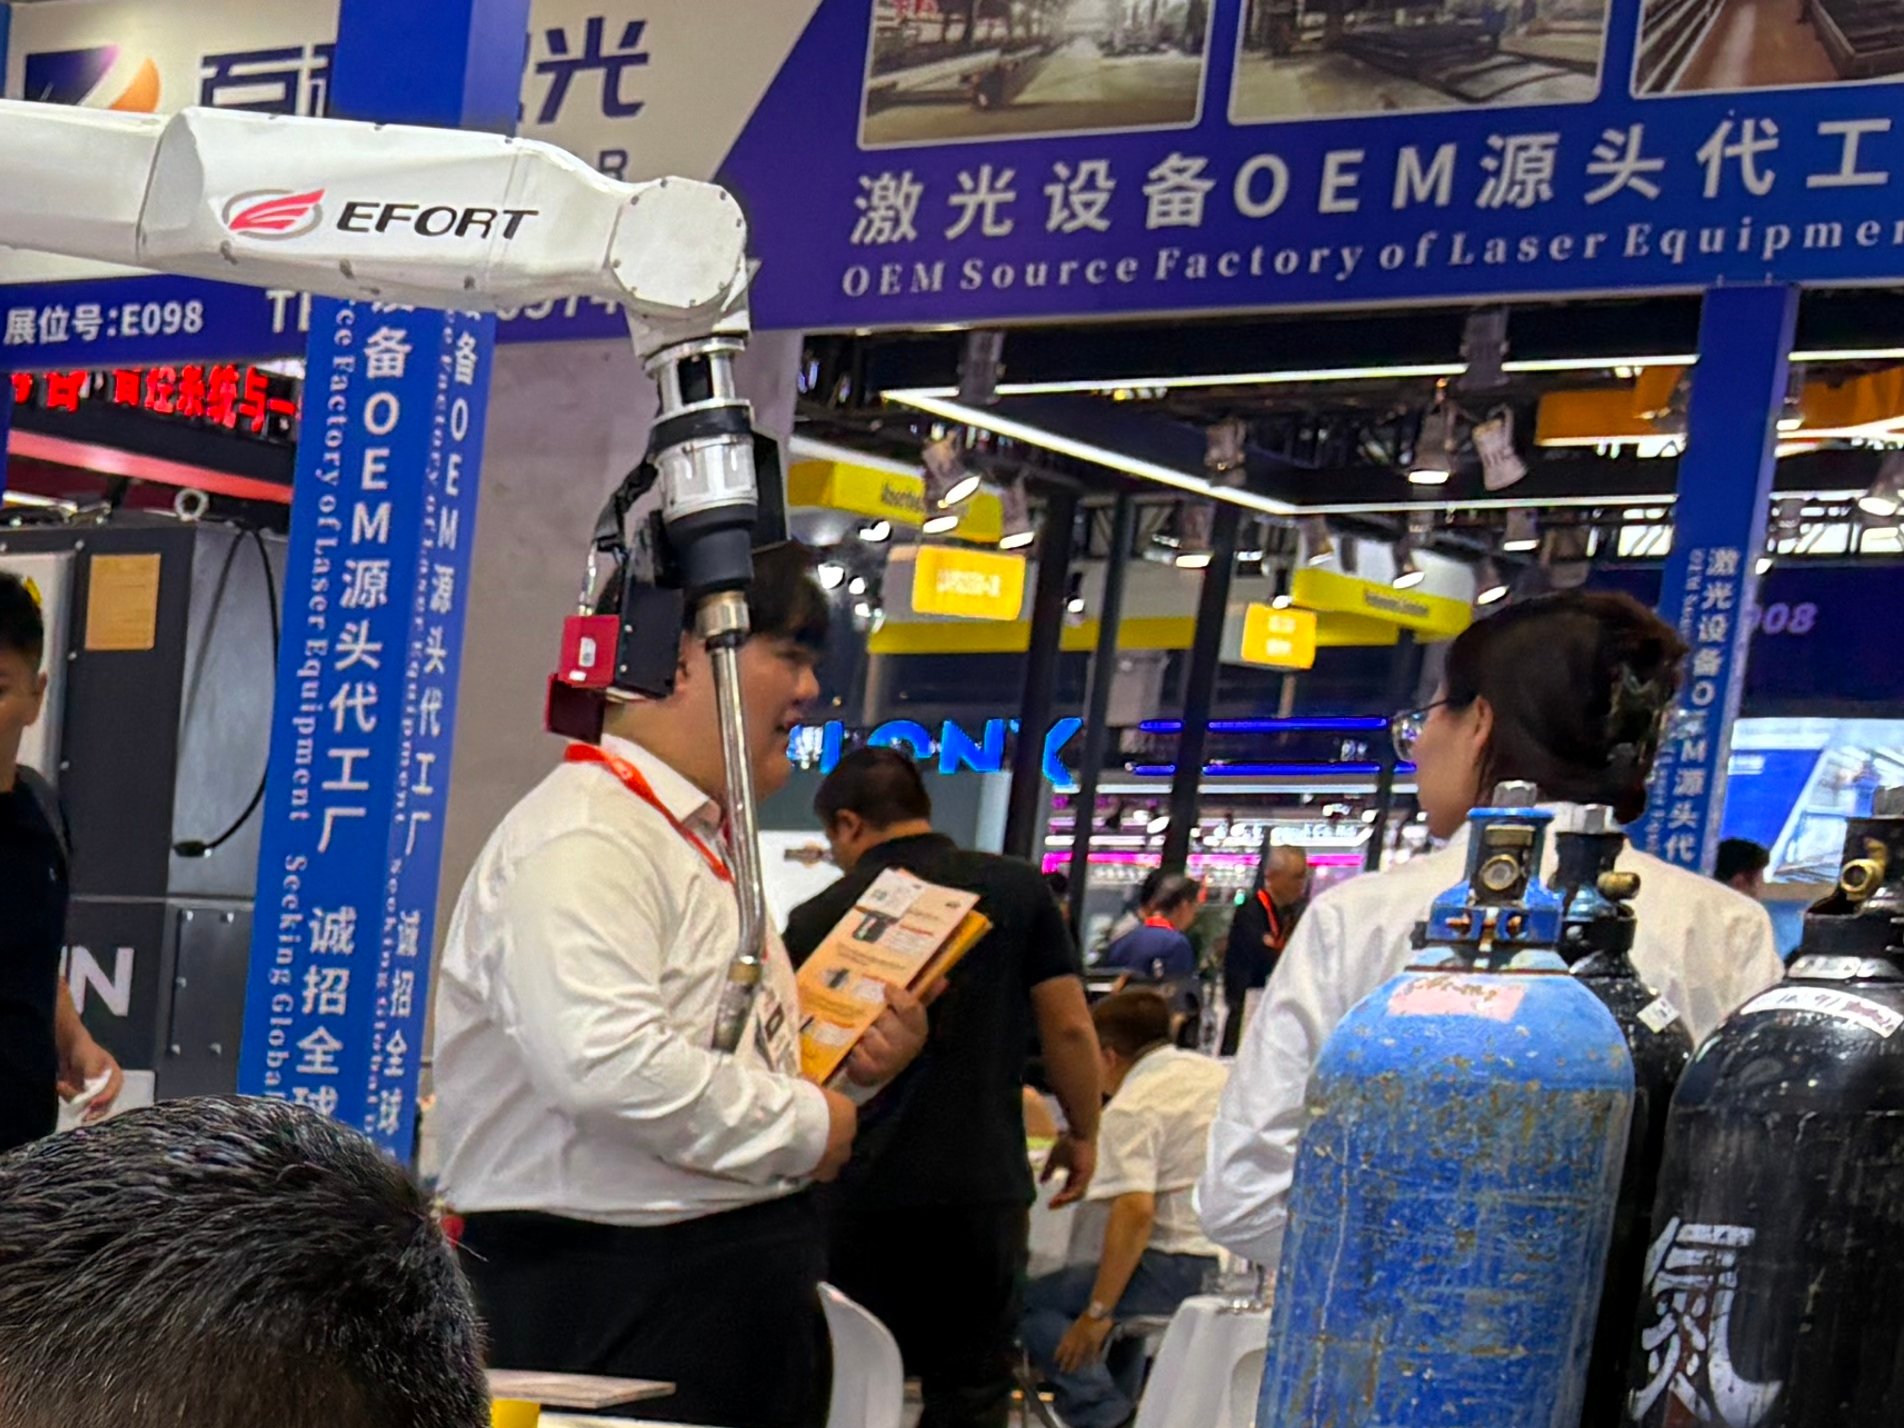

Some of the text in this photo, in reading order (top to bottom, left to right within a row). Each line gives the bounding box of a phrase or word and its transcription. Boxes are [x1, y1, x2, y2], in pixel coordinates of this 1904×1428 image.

[849, 118, 1894, 245] 激光设备OEM源头代工
[336, 201, 539, 240] EFORT
[842, 261, 946, 297] OEM
[959, 253, 1139, 291] Source
[1154, 244, 1364, 282] Factory
[1379, 231, 1437, 270] of
[1449, 231, 1609, 266] Laser
[2, 300, 205, 346] 展位号:E098
[317, 302, 414, 852] 备OEM源头代工厂
